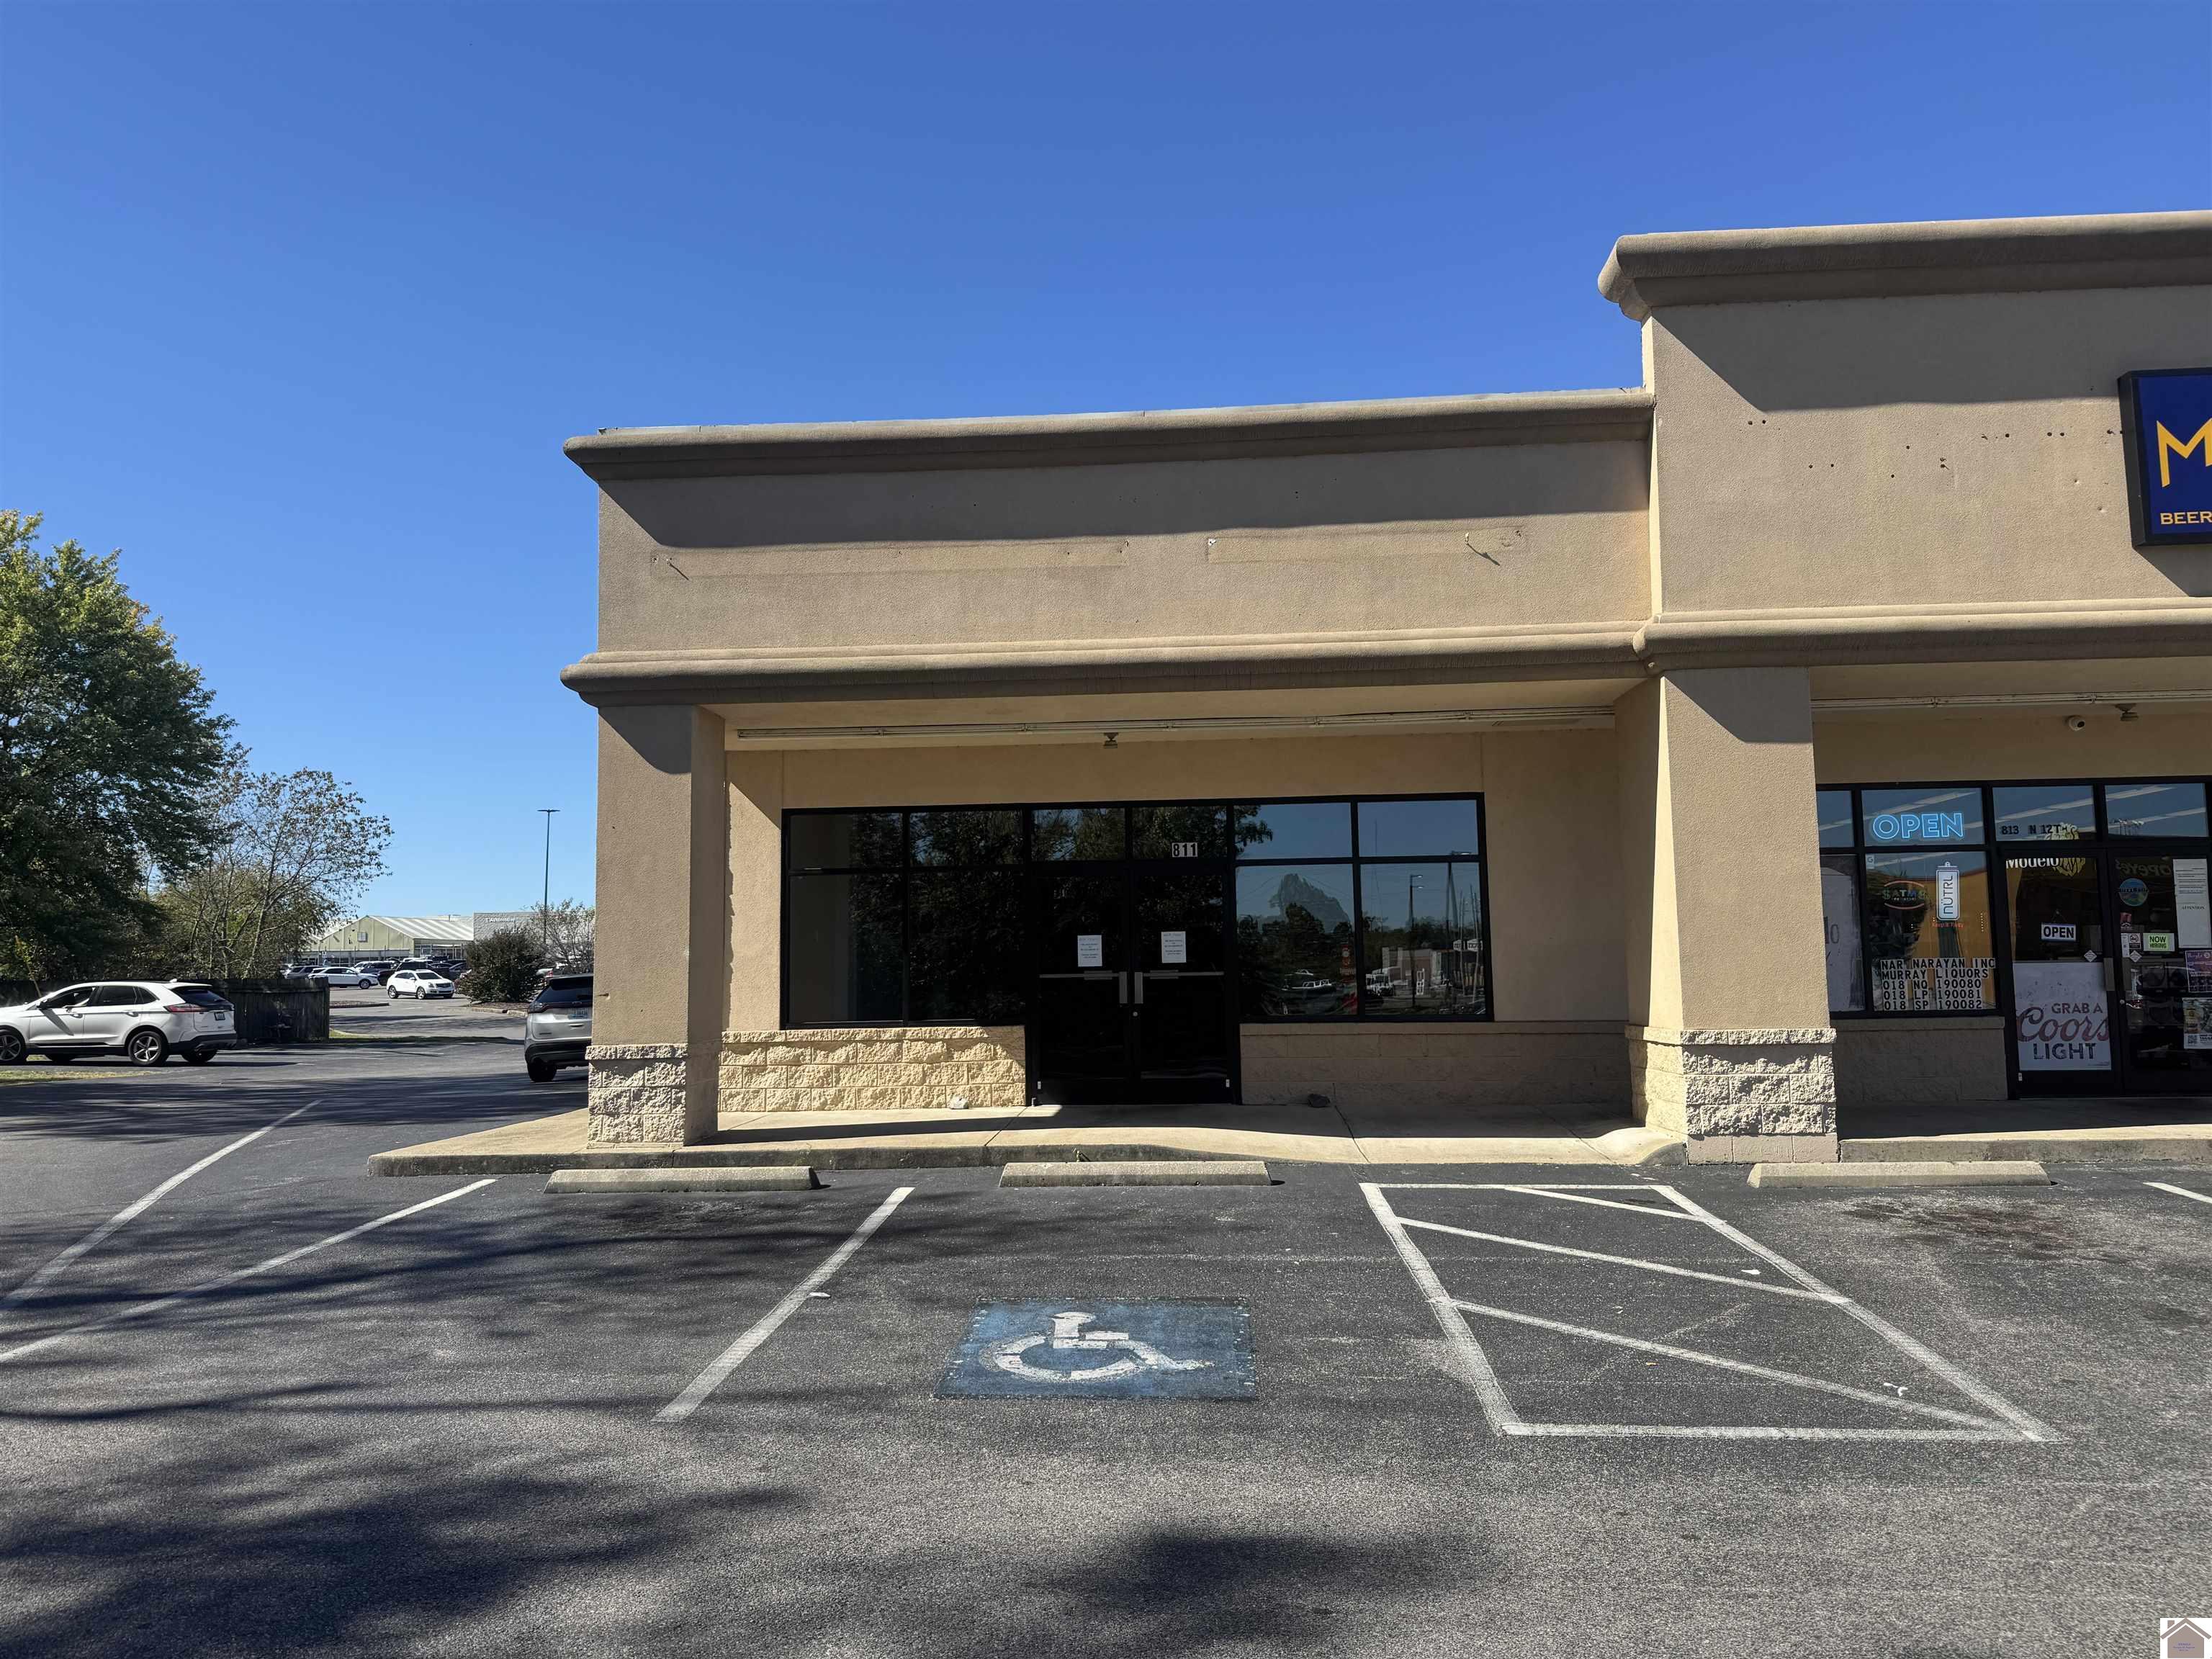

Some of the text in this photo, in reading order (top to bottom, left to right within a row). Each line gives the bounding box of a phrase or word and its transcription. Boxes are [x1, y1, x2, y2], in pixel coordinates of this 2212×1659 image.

[2160, 511, 2212, 525] BEER
[1873, 813, 1964, 840] OPEN
[2002, 825, 2020, 835] 813
[2028, 824, 2036, 834] N
[1173, 843, 1197, 856] 811
[2044, 926, 2074, 938] OPEN
[1881, 958, 1995, 970] NAR NARAYAN INC
[1882, 968, 1988, 980] MURRAY LIQUORS
[1883, 981, 1905, 990] 018
[1937, 979, 1982, 989] 190080
[1884, 989, 1981, 1000] 018 LP 190081
[1884, 999, 1982, 1010] 018 SP 190082
[2051, 1003, 2103, 1014] GRAB A
[2016, 1007, 2109, 1042] Coors
[2033, 1043, 2097, 1060] LIGHT
